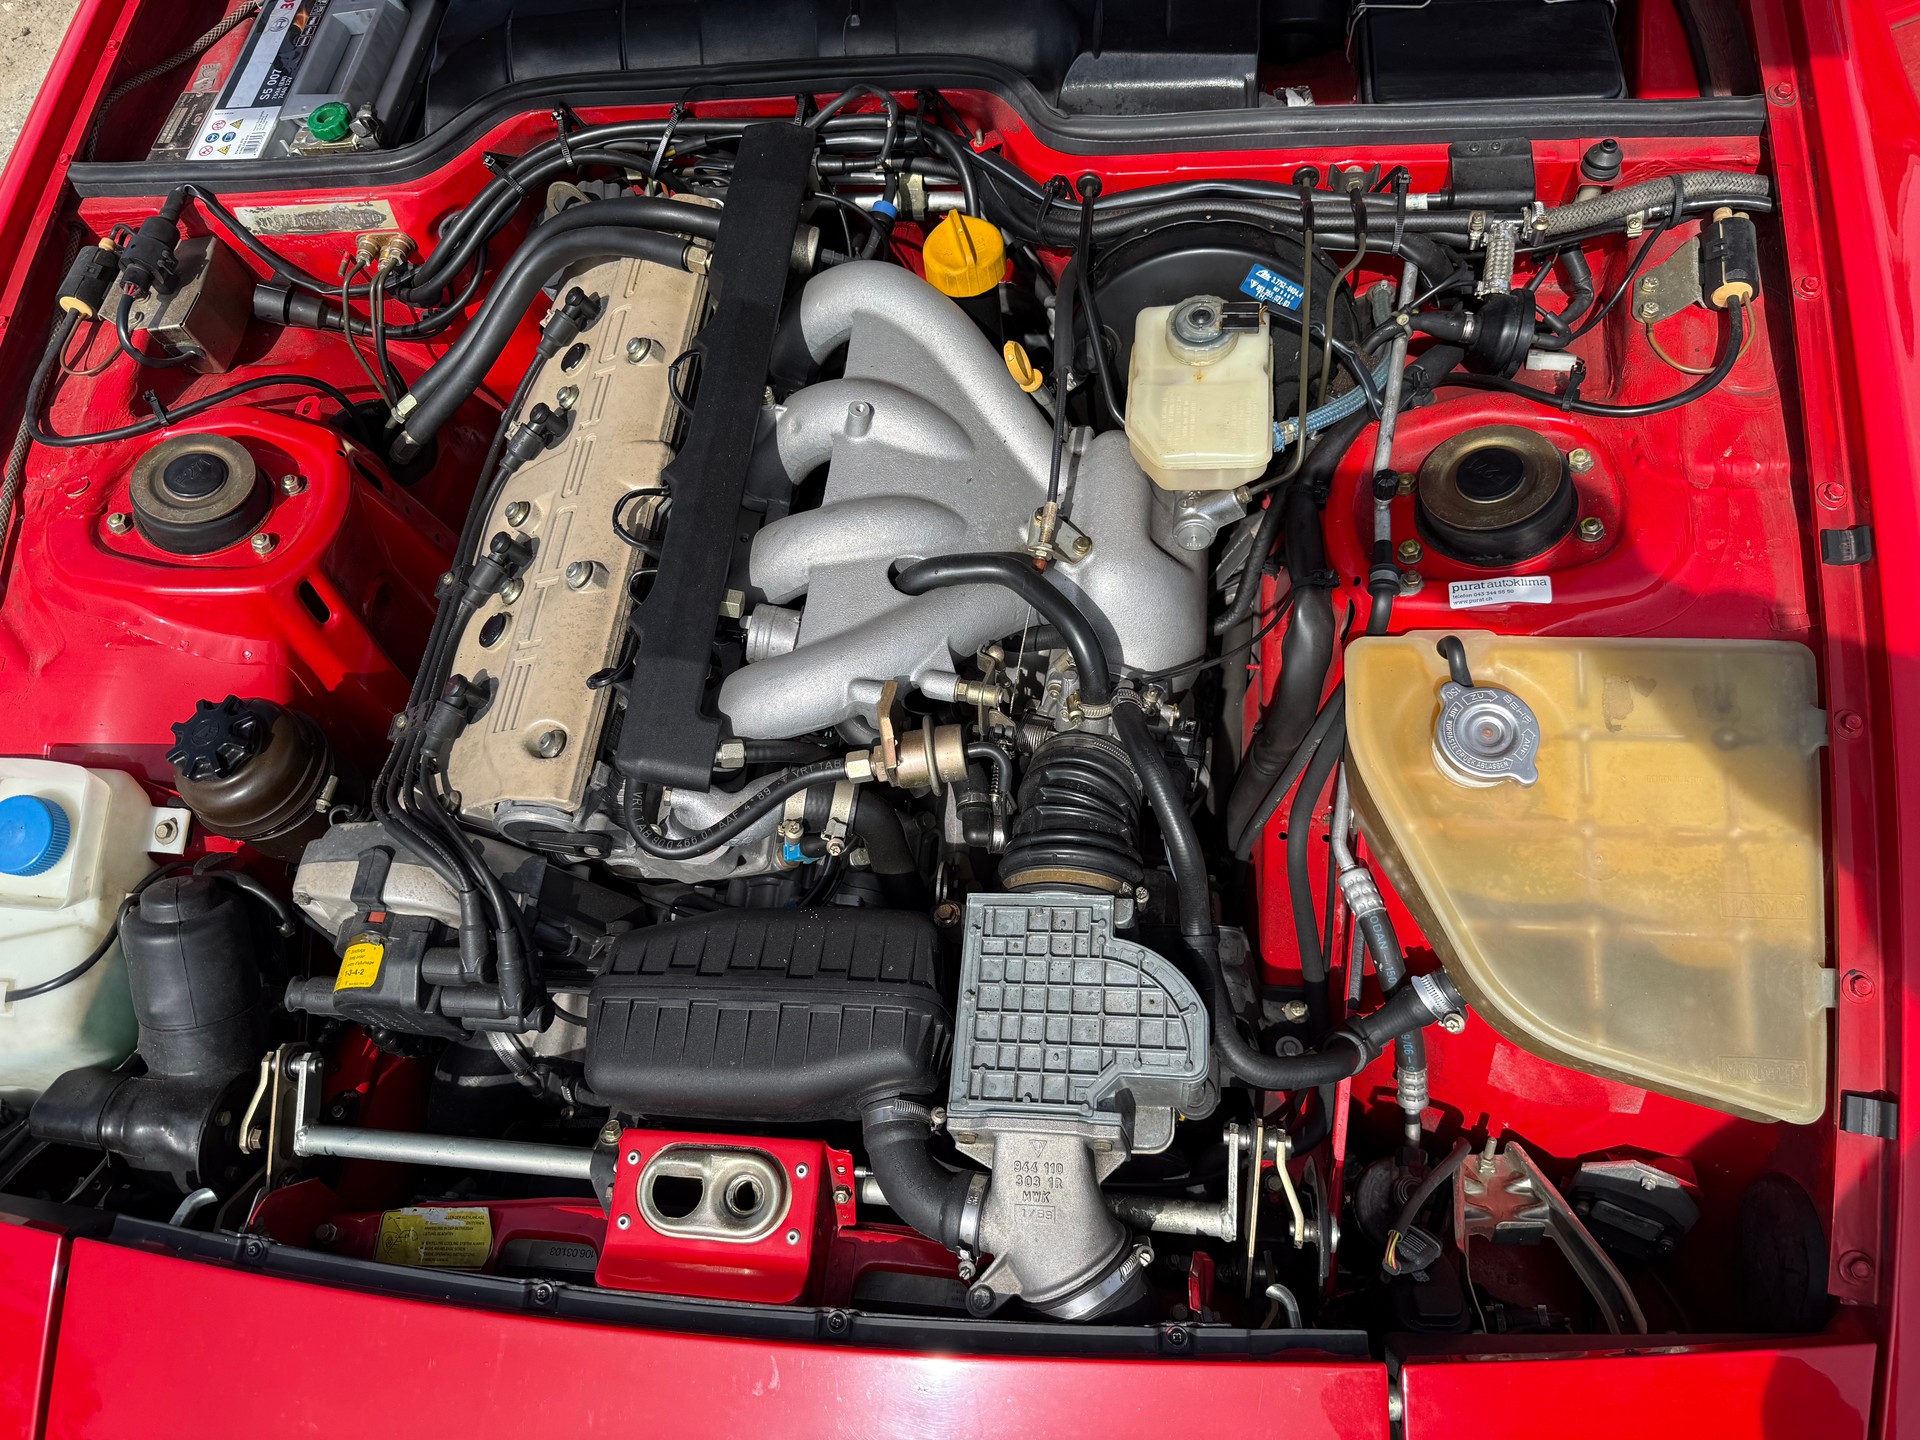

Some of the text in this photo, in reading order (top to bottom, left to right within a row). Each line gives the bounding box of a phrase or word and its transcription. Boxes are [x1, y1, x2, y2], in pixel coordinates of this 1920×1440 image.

[259, 69, 283, 100] S5 007
[1451, 582, 1485, 594] purat
[1452, 596, 1493, 605] www.purat.ch
[1470, 692, 1484, 701] ZU
[1519, 737, 1531, 756] AUF
[792, 759, 842, 778] VRT TAB
[1476, 761, 1510, 770] ABLASSEN
[756, 787, 772, 801] 89
[631, 791, 644, 812] VRT
[634, 815, 653, 839] TAB
[718, 812, 740, 830] AAF
[651, 836, 674, 850] 900
[676, 836, 698, 849] 466
[1385, 966, 1398, 985] 150
[1013, 1160, 1064, 1175] 944 110
[1015, 1174, 1063, 1189] 303 1R
[1022, 1190, 1051, 1203] MWK
[549, 1246, 595, 1259] 106.031.03
